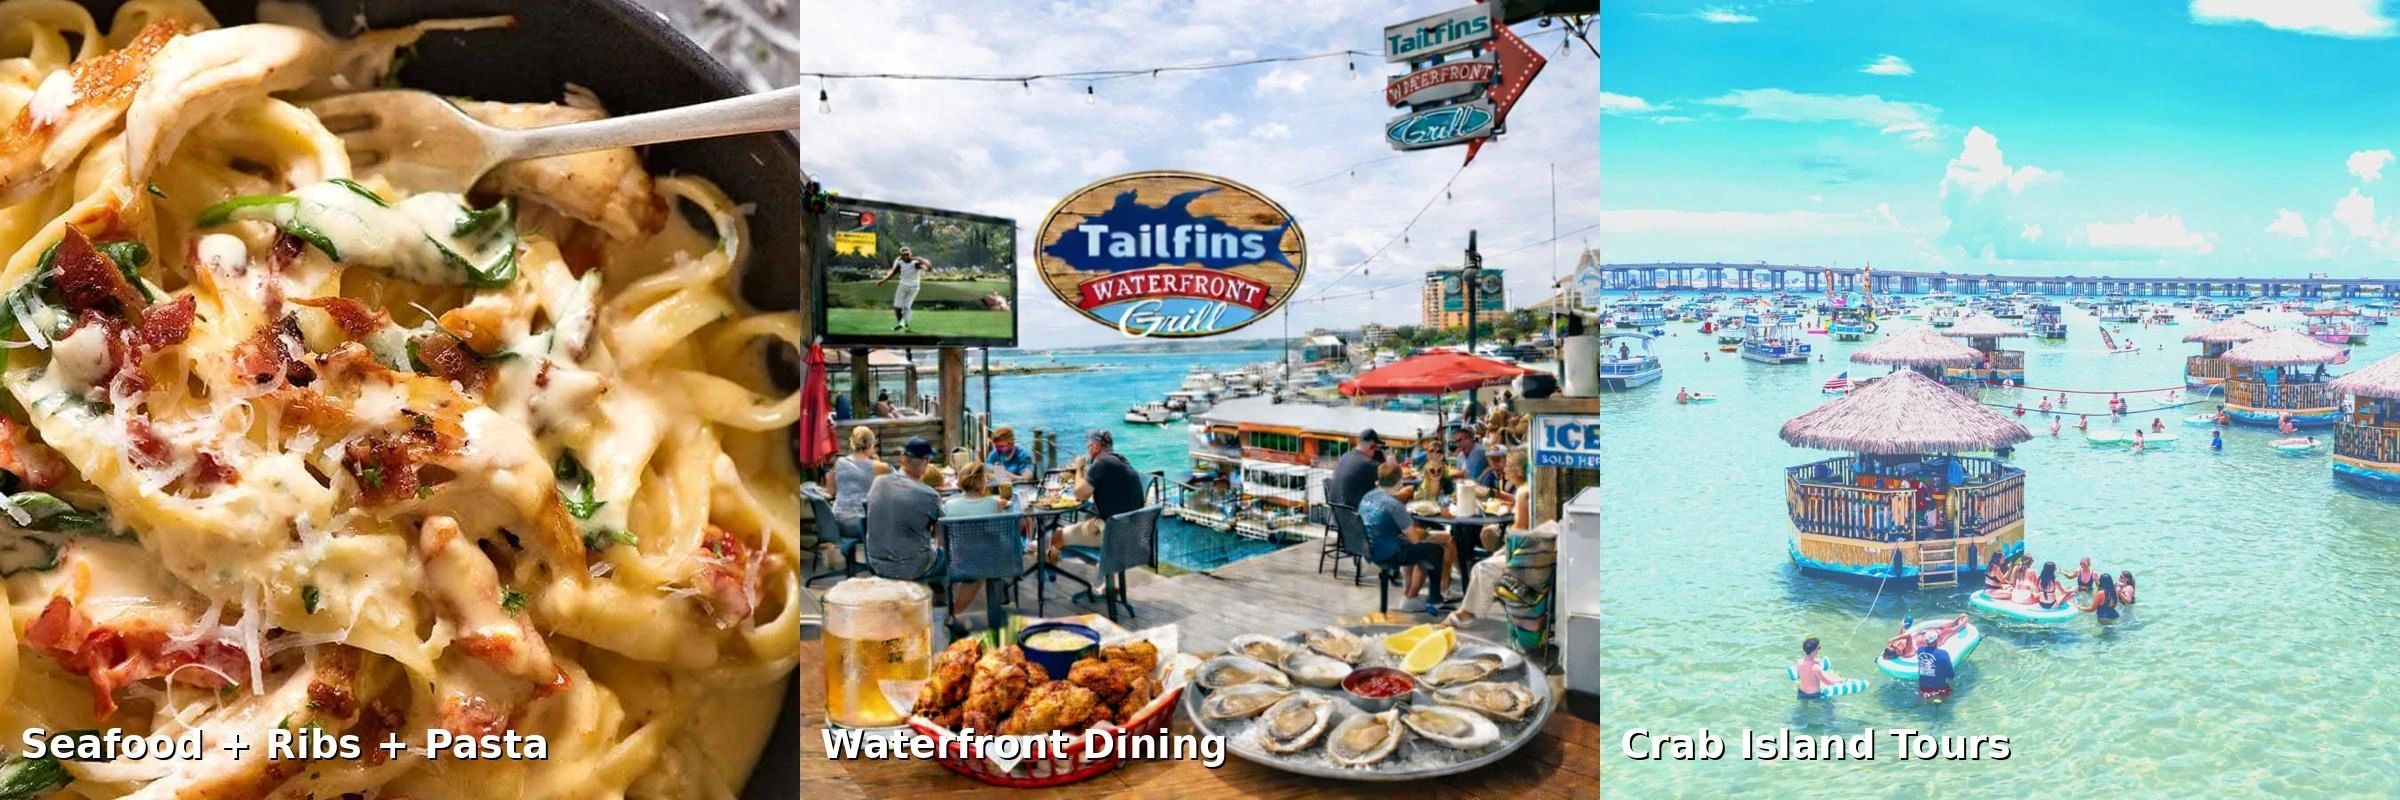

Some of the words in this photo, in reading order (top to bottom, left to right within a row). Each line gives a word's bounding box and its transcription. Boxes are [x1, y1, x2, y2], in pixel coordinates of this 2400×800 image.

[1388, 15, 1489, 56] Tailfins
[1401, 106, 1473, 145] Grill
[1544, 421, 1600, 450] ICE
[1541, 454, 1574, 466] SOLD
